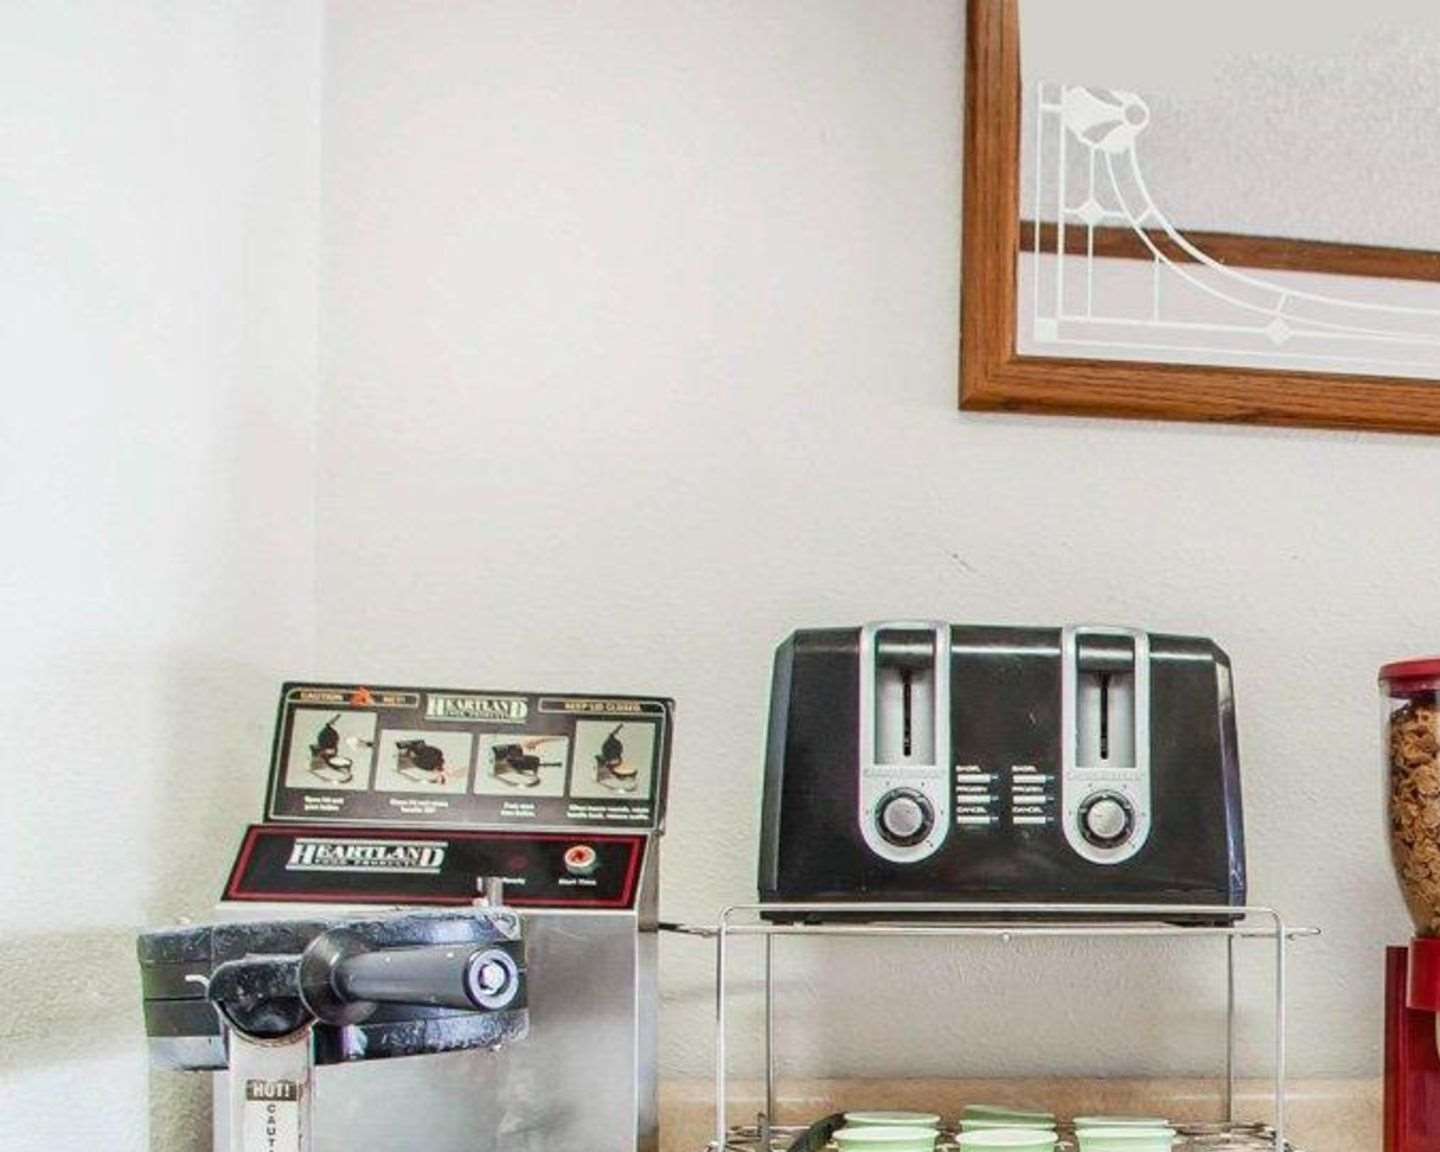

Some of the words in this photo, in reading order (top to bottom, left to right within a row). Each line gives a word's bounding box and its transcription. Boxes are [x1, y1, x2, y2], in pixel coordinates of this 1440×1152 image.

[427, 697, 528, 719] HEARTLAND
[288, 843, 445, 867] HEARTLAND
[253, 1082, 290, 1098] HOT!
